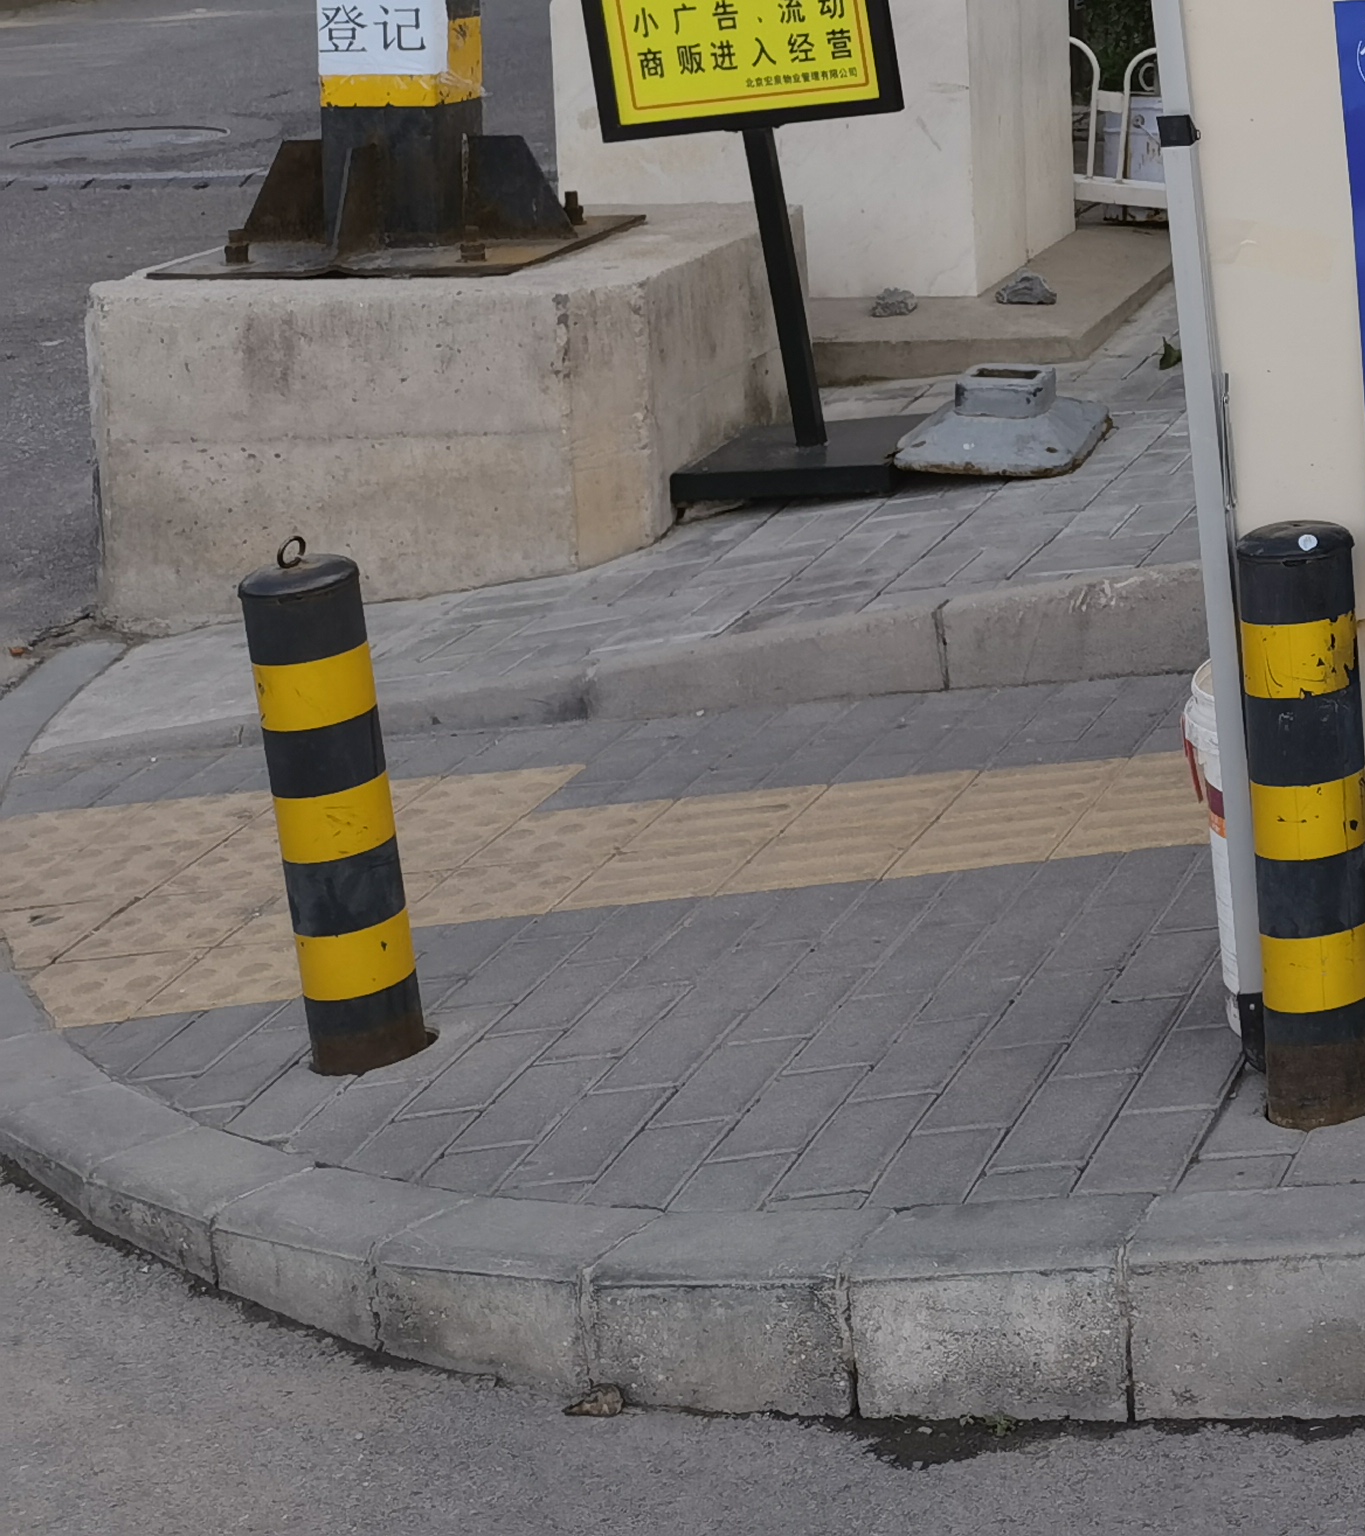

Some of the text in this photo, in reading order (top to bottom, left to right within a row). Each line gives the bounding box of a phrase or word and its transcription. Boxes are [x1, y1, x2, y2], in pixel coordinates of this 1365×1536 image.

[318, 4, 428, 54] 登记
[637, 27, 854, 81] 商贩进入经营
